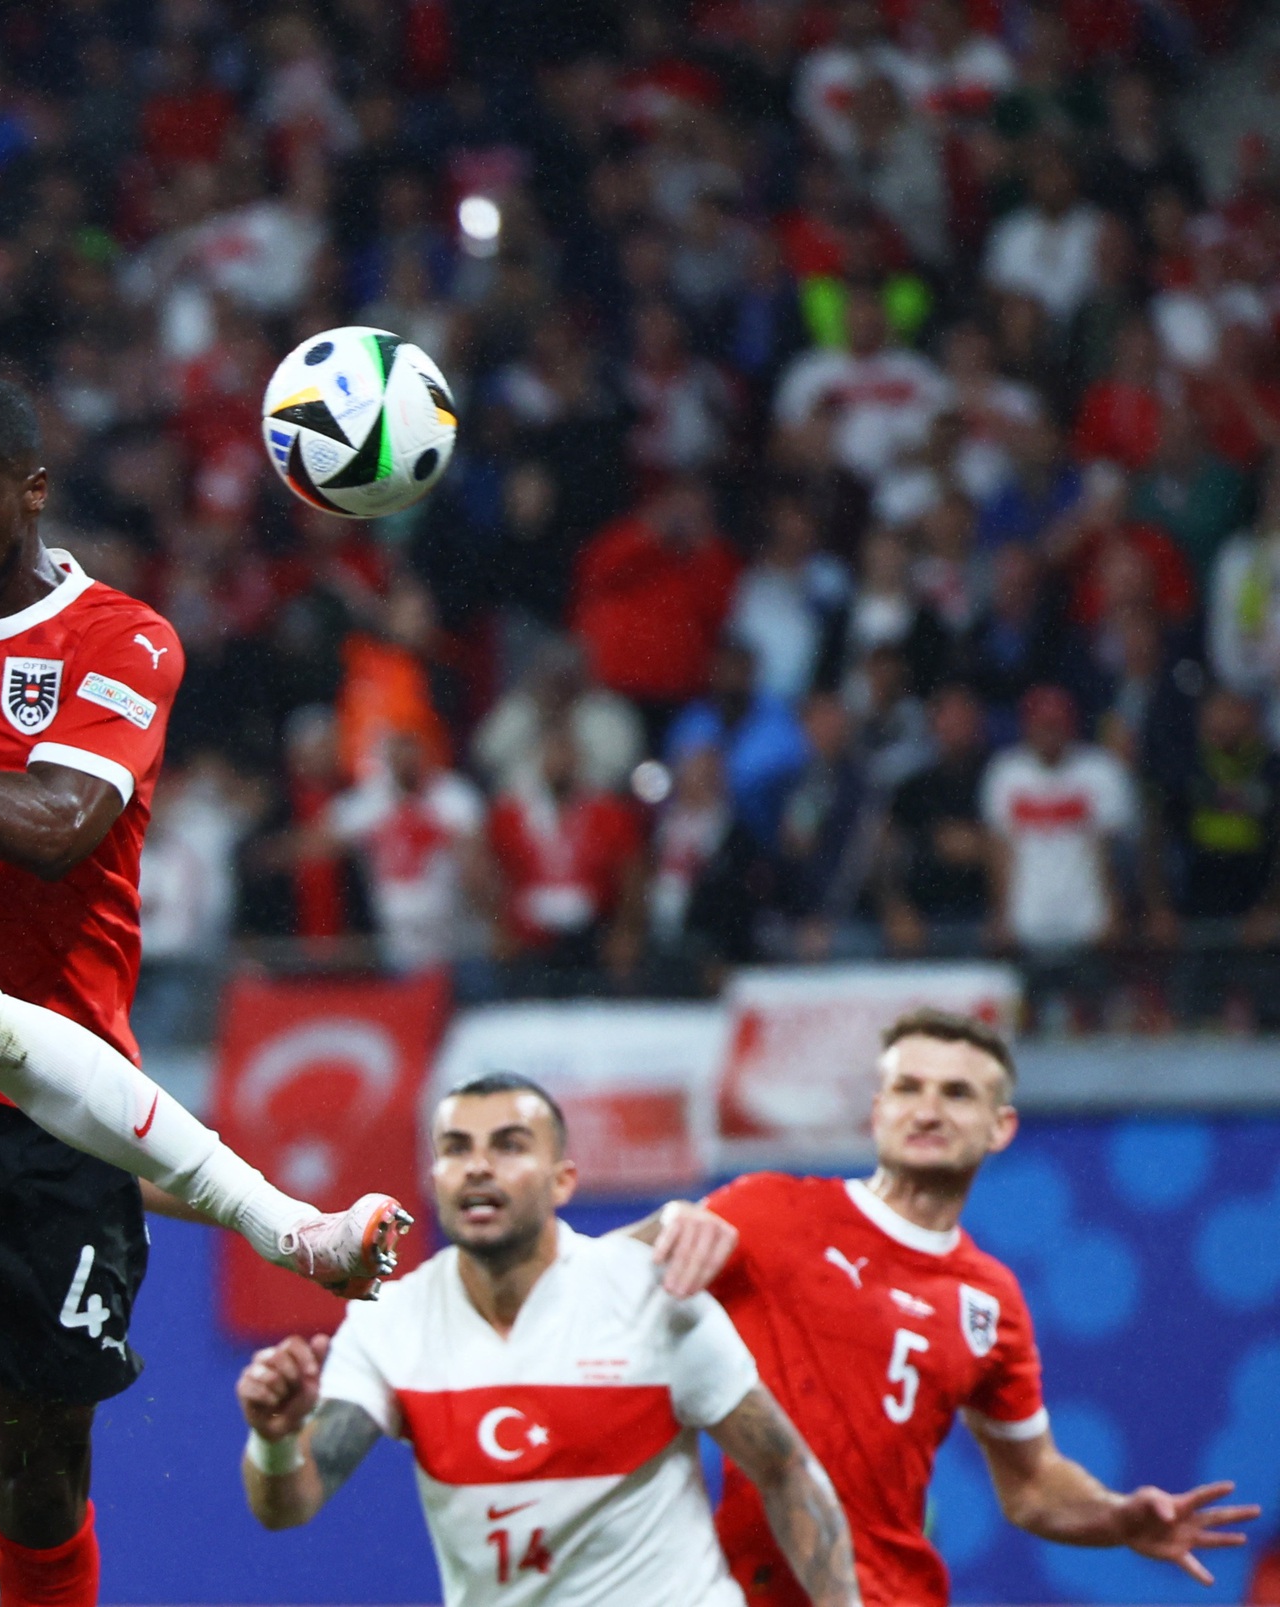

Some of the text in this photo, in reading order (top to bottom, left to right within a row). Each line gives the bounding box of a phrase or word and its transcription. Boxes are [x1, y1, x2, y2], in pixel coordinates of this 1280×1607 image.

[83, 680, 152, 720] FOUNDATION
[60, 1244, 110, 1338] 4
[883, 1328, 930, 1424] 5
[487, 1528, 552, 1584] 14
